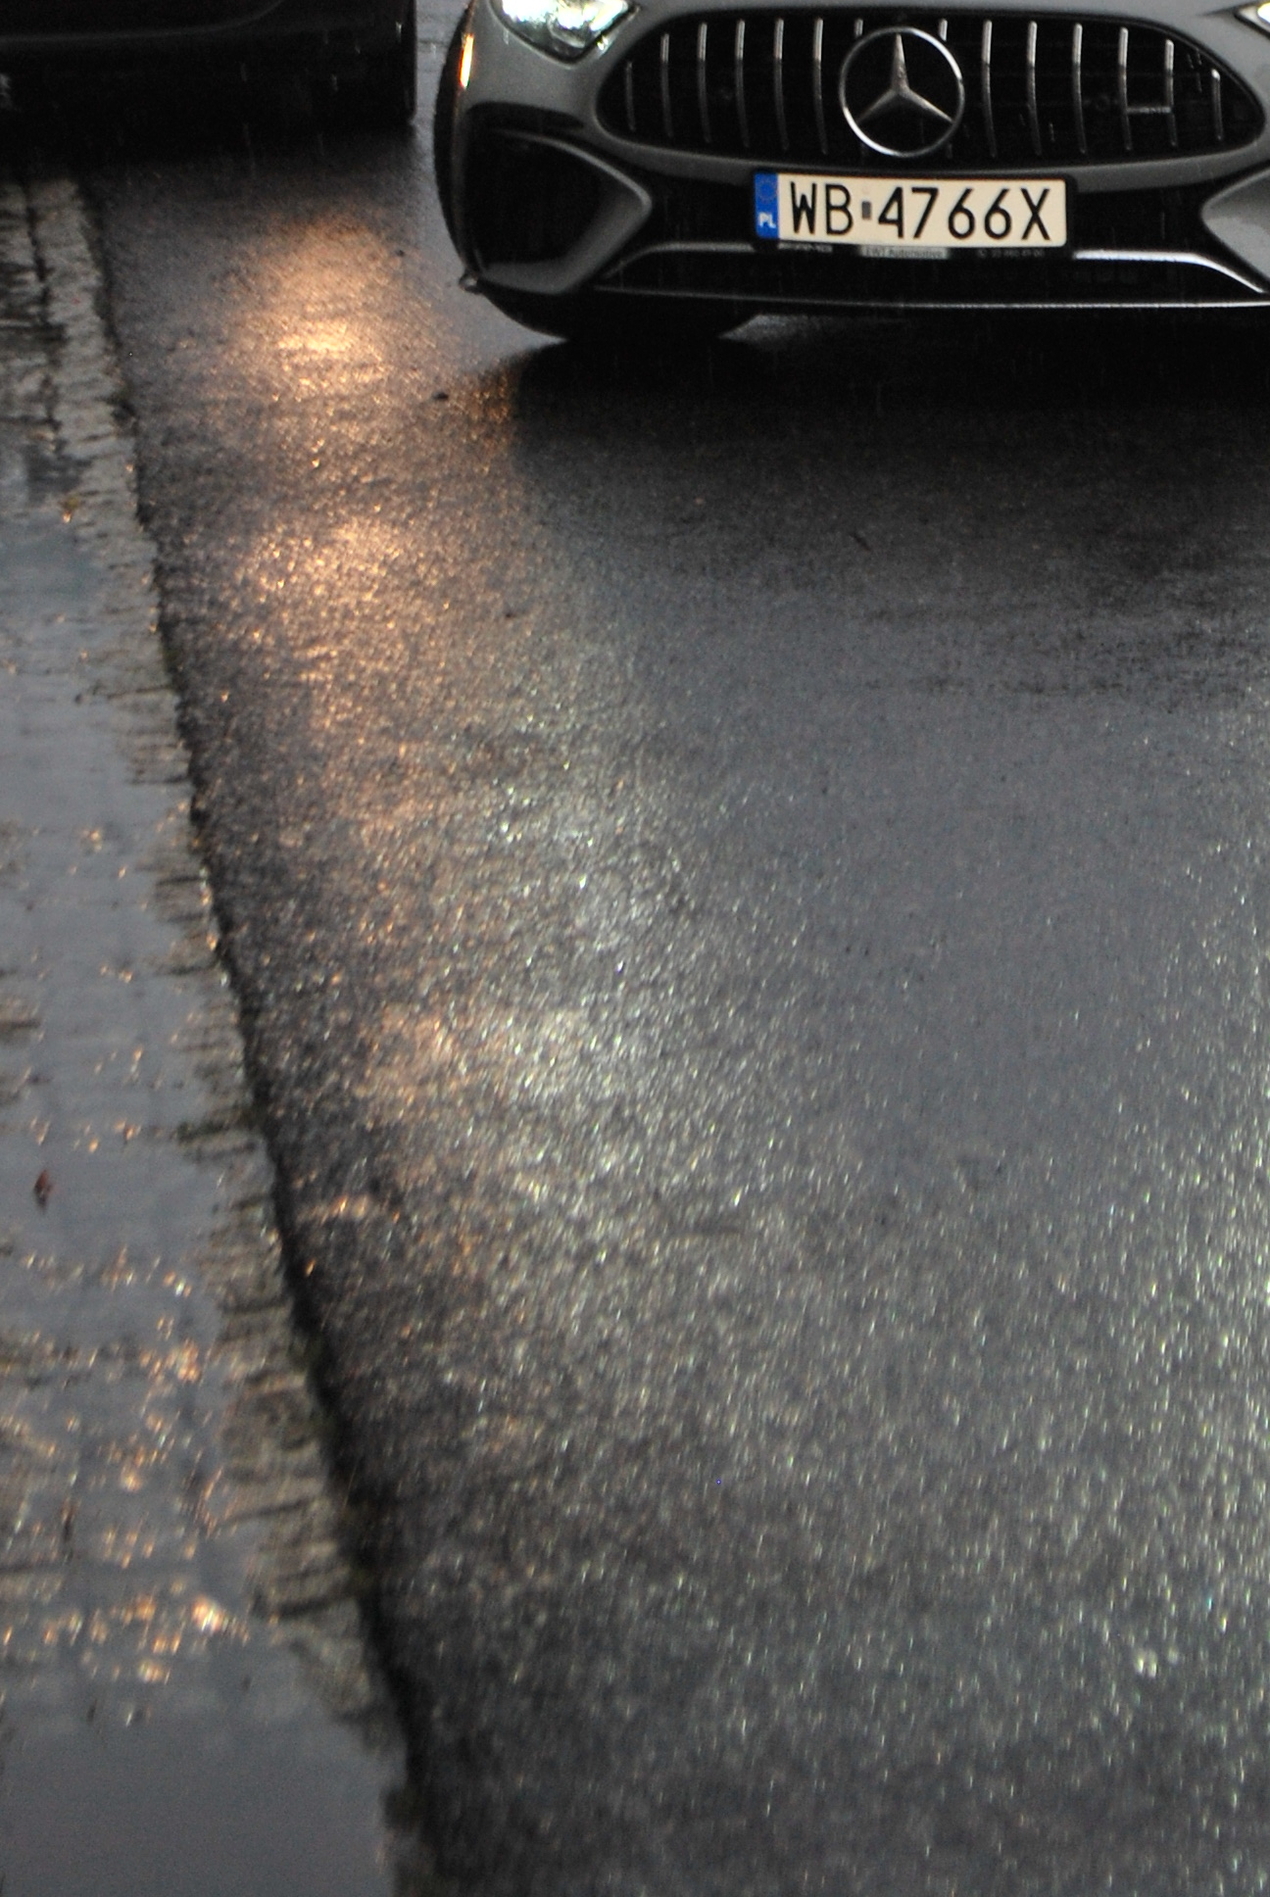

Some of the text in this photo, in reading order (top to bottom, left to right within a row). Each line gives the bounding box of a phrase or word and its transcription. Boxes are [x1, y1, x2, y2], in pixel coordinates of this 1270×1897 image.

[758, 212, 776, 229] PL
[790, 181, 1051, 241] WB 4766X
